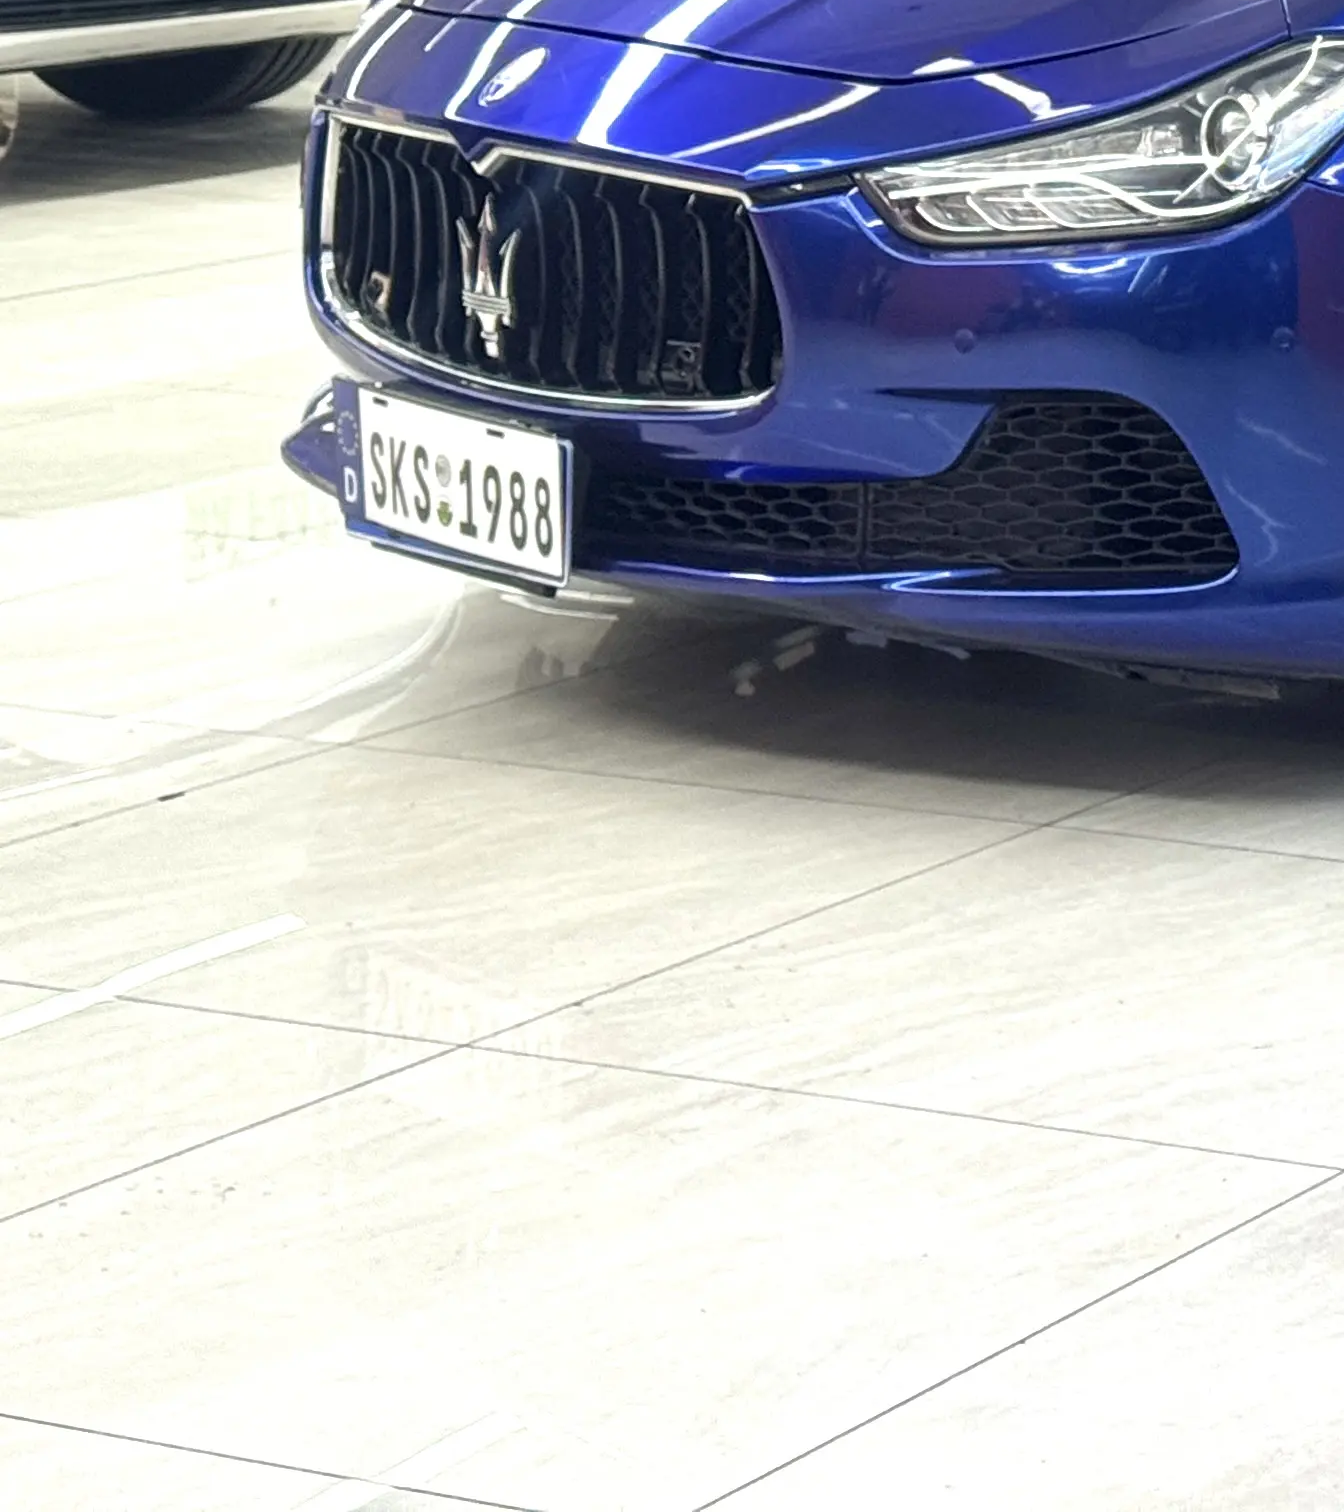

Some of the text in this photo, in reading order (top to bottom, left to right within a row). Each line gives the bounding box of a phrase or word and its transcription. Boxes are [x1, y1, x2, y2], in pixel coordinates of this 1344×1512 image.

[344, 467, 358, 503] D
[370, 431, 554, 558] SKS 1988
